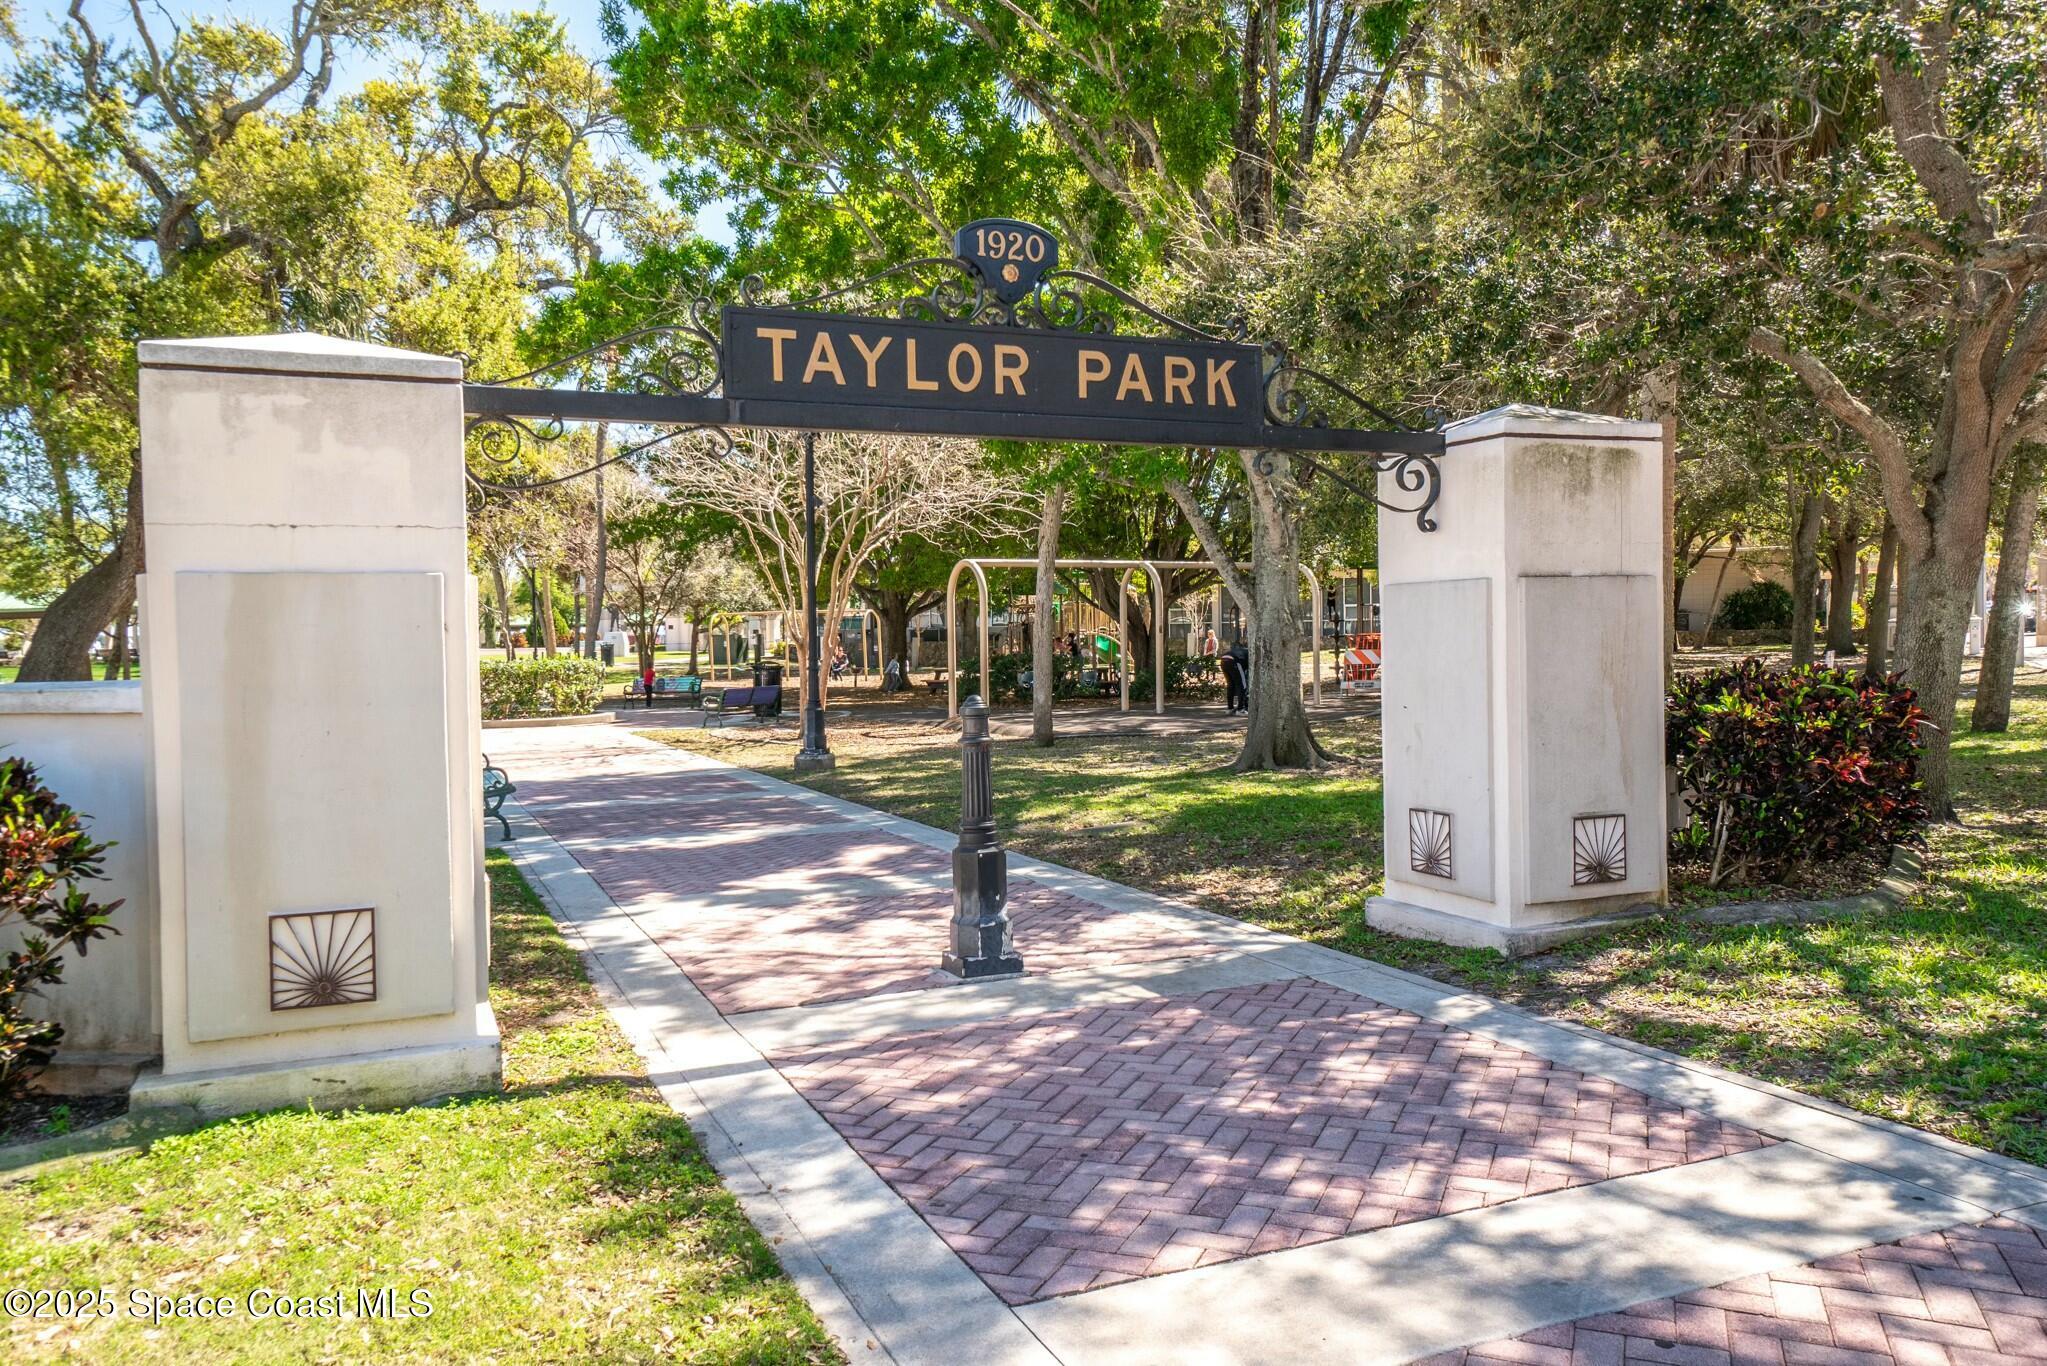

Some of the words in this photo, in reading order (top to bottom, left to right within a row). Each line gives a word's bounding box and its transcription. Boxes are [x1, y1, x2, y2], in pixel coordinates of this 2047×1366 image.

[976, 229, 1045, 262] 1920
[756, 327, 1029, 396] TAYLOR
[1078, 350, 1237, 407] PARK
